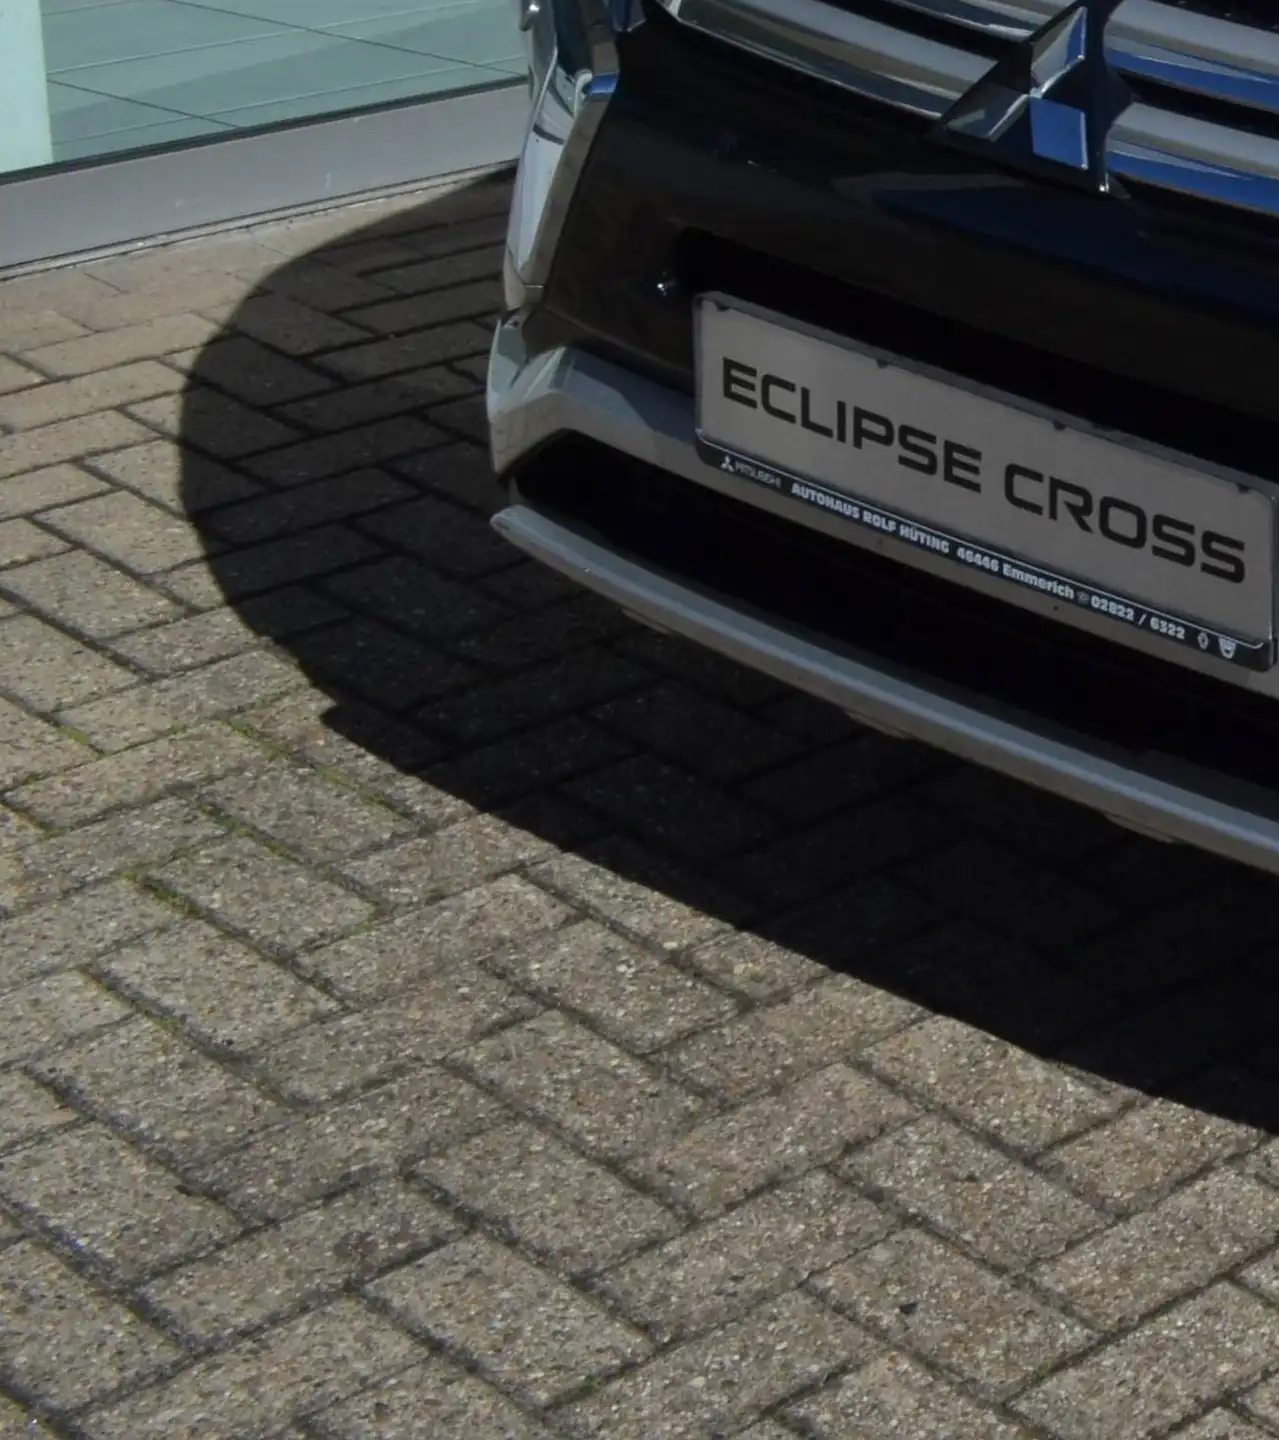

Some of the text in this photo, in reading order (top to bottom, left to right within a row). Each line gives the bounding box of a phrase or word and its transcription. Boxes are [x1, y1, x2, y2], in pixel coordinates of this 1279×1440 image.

[721, 356, 1246, 584] ECLIPSE CROSS
[791, 482, 861, 520] AUTOHAUS
[862, 509, 897, 535] ROLF
[1002, 561, 1075, 601] Emmerich
[1089, 594, 1136, 622] 02822
[1149, 616, 1186, 640] 6322
